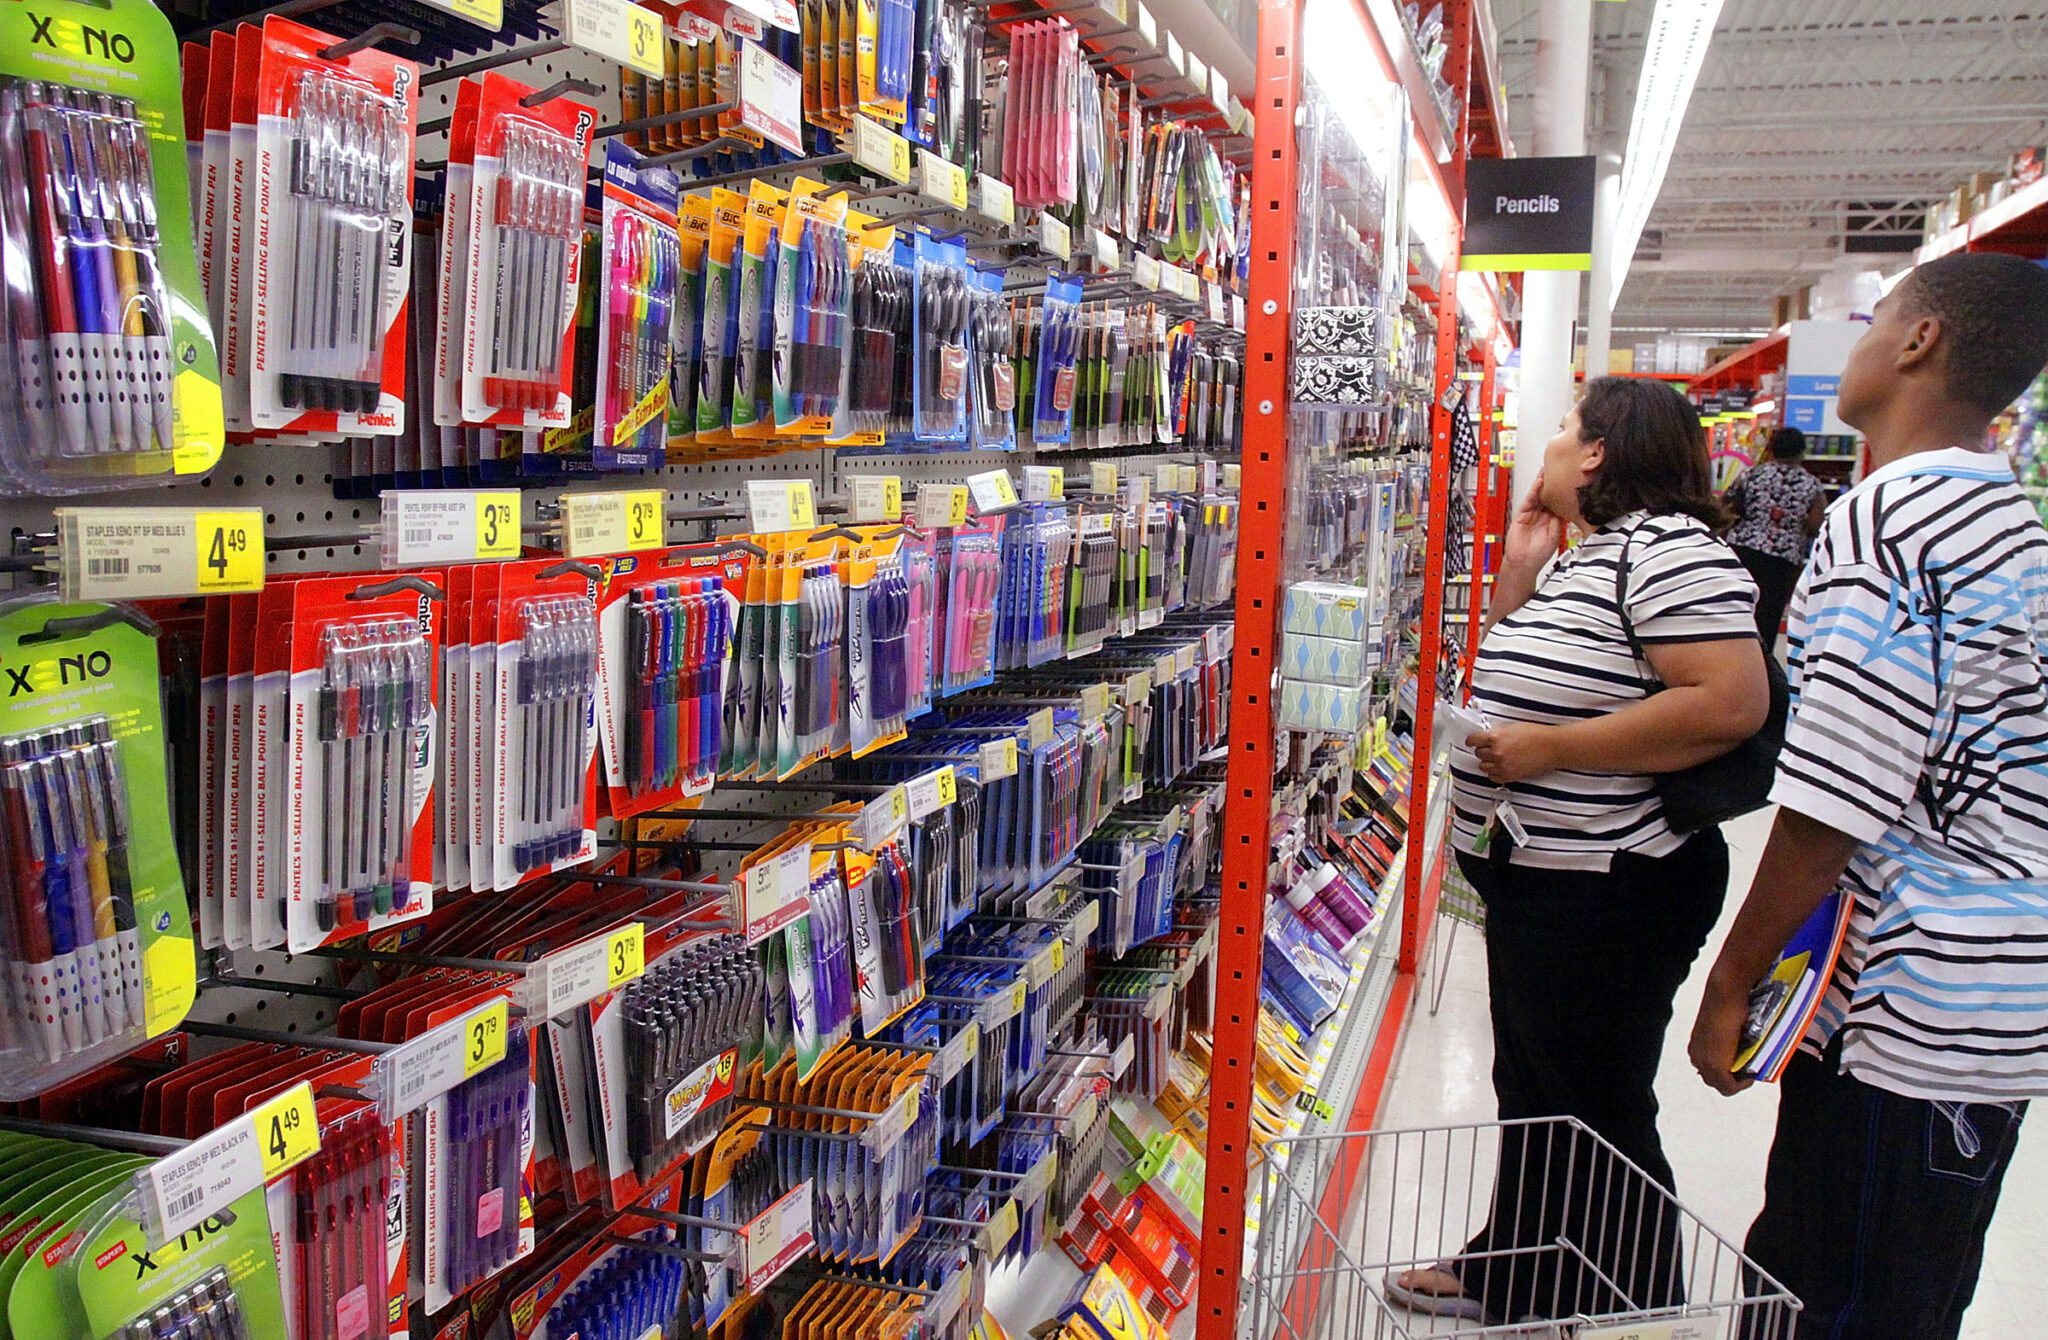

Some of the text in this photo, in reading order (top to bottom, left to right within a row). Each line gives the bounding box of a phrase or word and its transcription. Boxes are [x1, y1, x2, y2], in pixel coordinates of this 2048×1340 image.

[26, 12, 135, 63] XENO
[207, 164, 217, 190] PEN
[235, 158, 243, 183] PEN
[262, 150, 271, 176] PEN
[205, 190, 216, 228] POINT
[233, 185, 242, 222] POINT
[261, 177, 270, 215] POINT
[1496, 195, 1560, 213] Pencils
[203, 231, 213, 259] BALL
[232, 226, 241, 254] BALL
[260, 219, 269, 247] BALL
[227, 325, 238, 377] PENTEL'S
[256, 320, 266, 371] PENTEL'S
[357, 412, 396, 428] Pentel
[86, 525, 115, 537] STAPLES
[116, 525, 132, 537] XENO
[166, 525, 181, 536] BLUE
[418, 595, 433, 634] entel
[5, 650, 112, 697] XENO
[207, 705, 216, 728] PEN
[233, 704, 241, 727] PEN
[258, 704, 267, 727] PEN
[296, 703, 304, 726] PEN
[207, 728, 215, 762] POINT
[232, 728, 240, 762] POINT
[258, 728, 266, 762] POINT
[295, 726, 304, 761] POINT
[206, 763, 215, 790] BALL
[231, 764, 240, 789] BALL
[257, 764, 266, 790] BALL
[295, 764, 303, 790] BALL
[206, 852, 214, 898] PENTEL'S
[230, 852, 238, 898] PENTEL'S
[257, 854, 265, 899] PENTEL'S
[293, 855, 302, 901] PENTEL'S
[161, 1164, 187, 1186] STAPLES
[186, 1156, 201, 1172] XENO
[221, 1137, 239, 1153] BLACK
[97, 1244, 125, 1267] STAPLES
